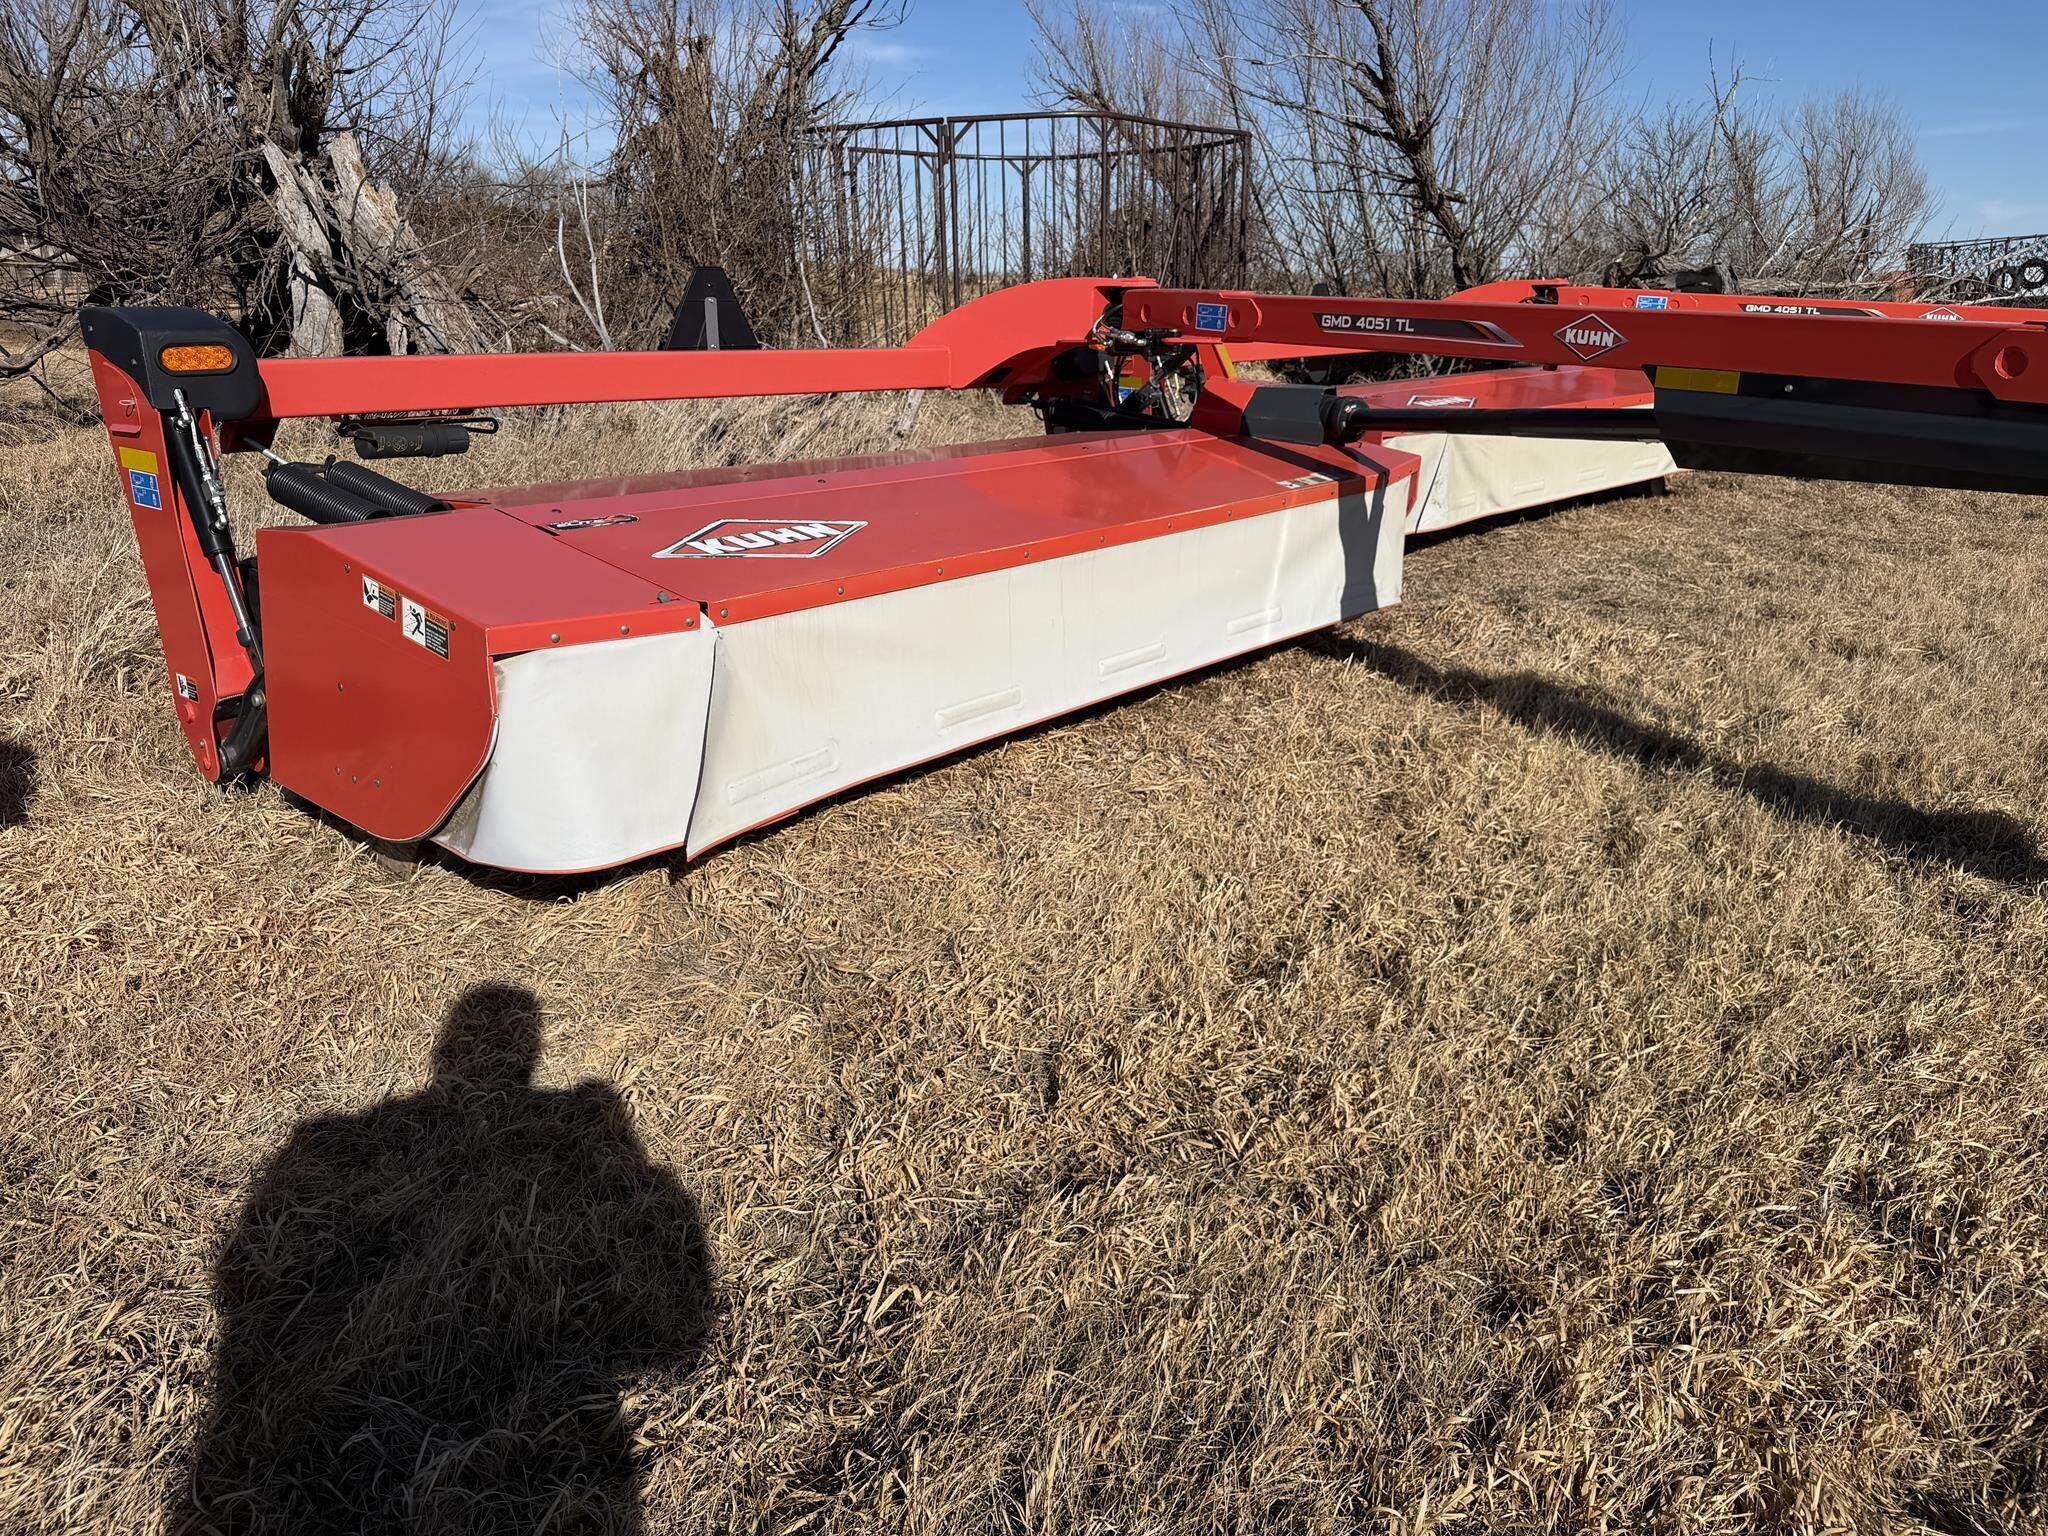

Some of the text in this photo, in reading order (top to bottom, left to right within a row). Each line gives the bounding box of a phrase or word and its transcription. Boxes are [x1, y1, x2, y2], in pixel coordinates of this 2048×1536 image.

[1745, 304, 1820, 315] GMD 4051 TL
[1321, 314, 1414, 332] GMD 4051 TL
[1565, 328, 1614, 347] KUHN
[686, 523, 845, 555] KUHN
